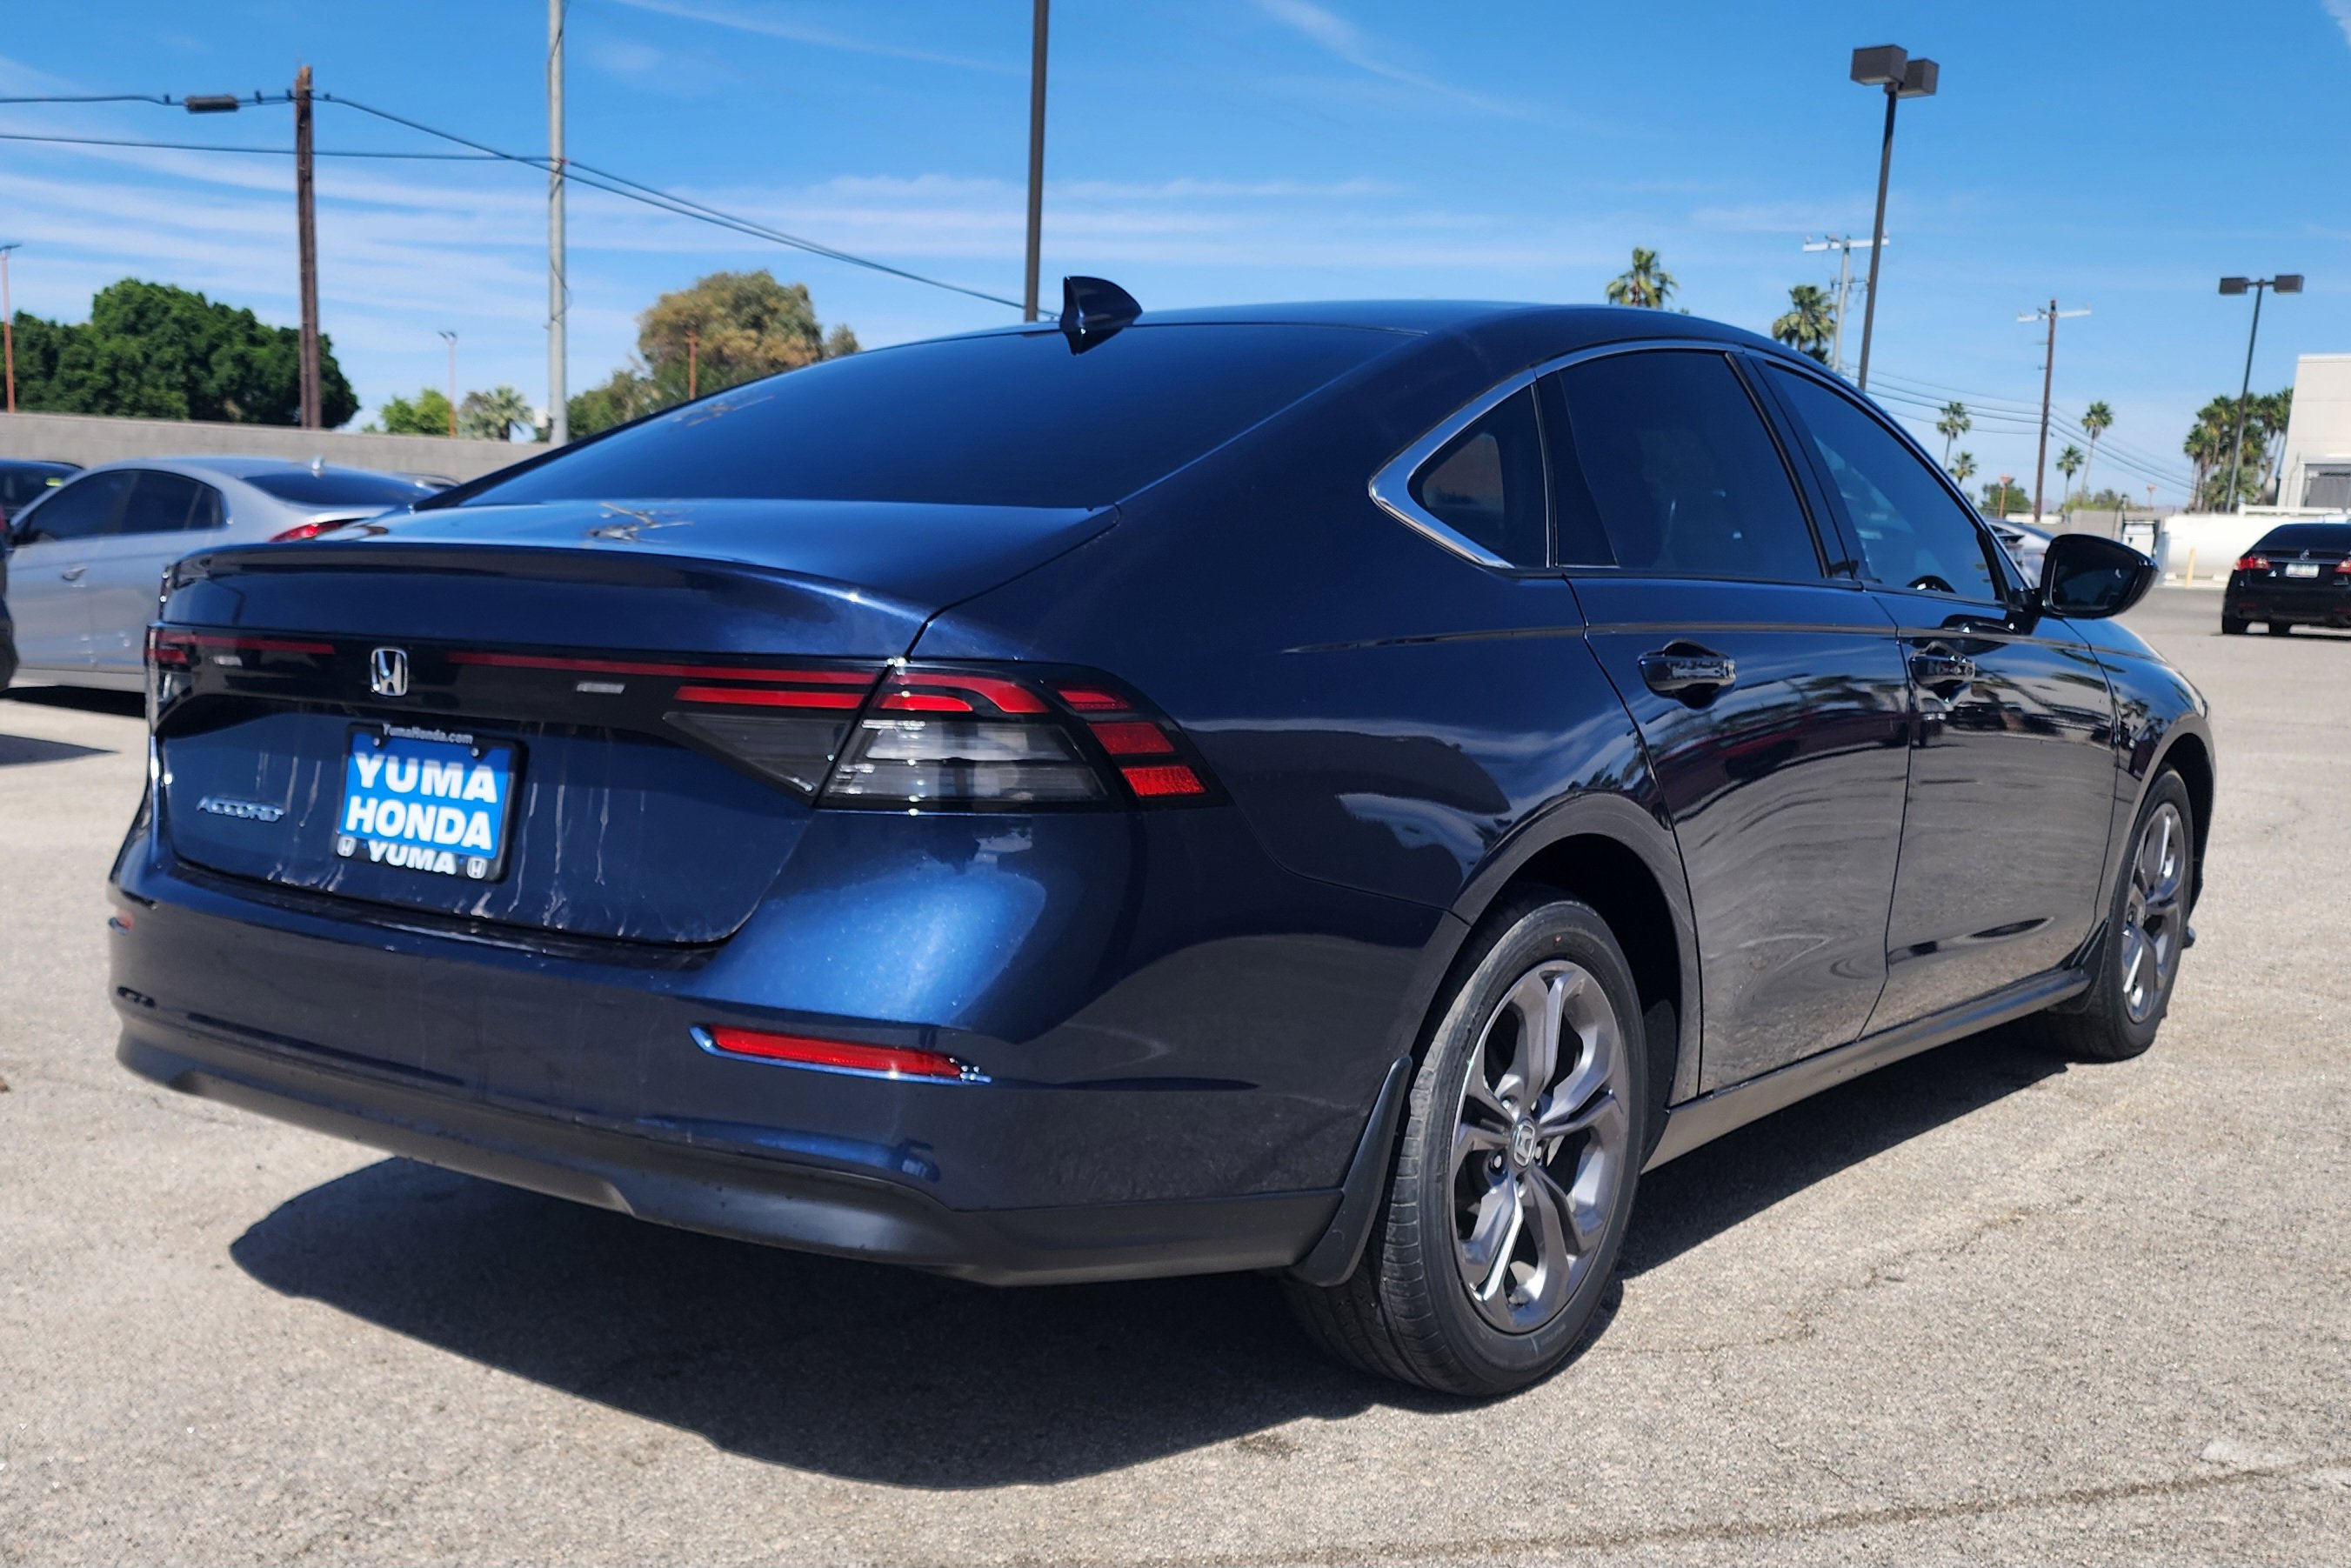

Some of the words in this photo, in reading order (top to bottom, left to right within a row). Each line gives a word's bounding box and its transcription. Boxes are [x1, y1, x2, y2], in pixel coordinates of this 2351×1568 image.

[382, 723, 474, 744] YumaHonda.com
[354, 751, 498, 804] YUMA
[345, 795, 492, 851] HONDA
[367, 839, 458, 876] YUMA
